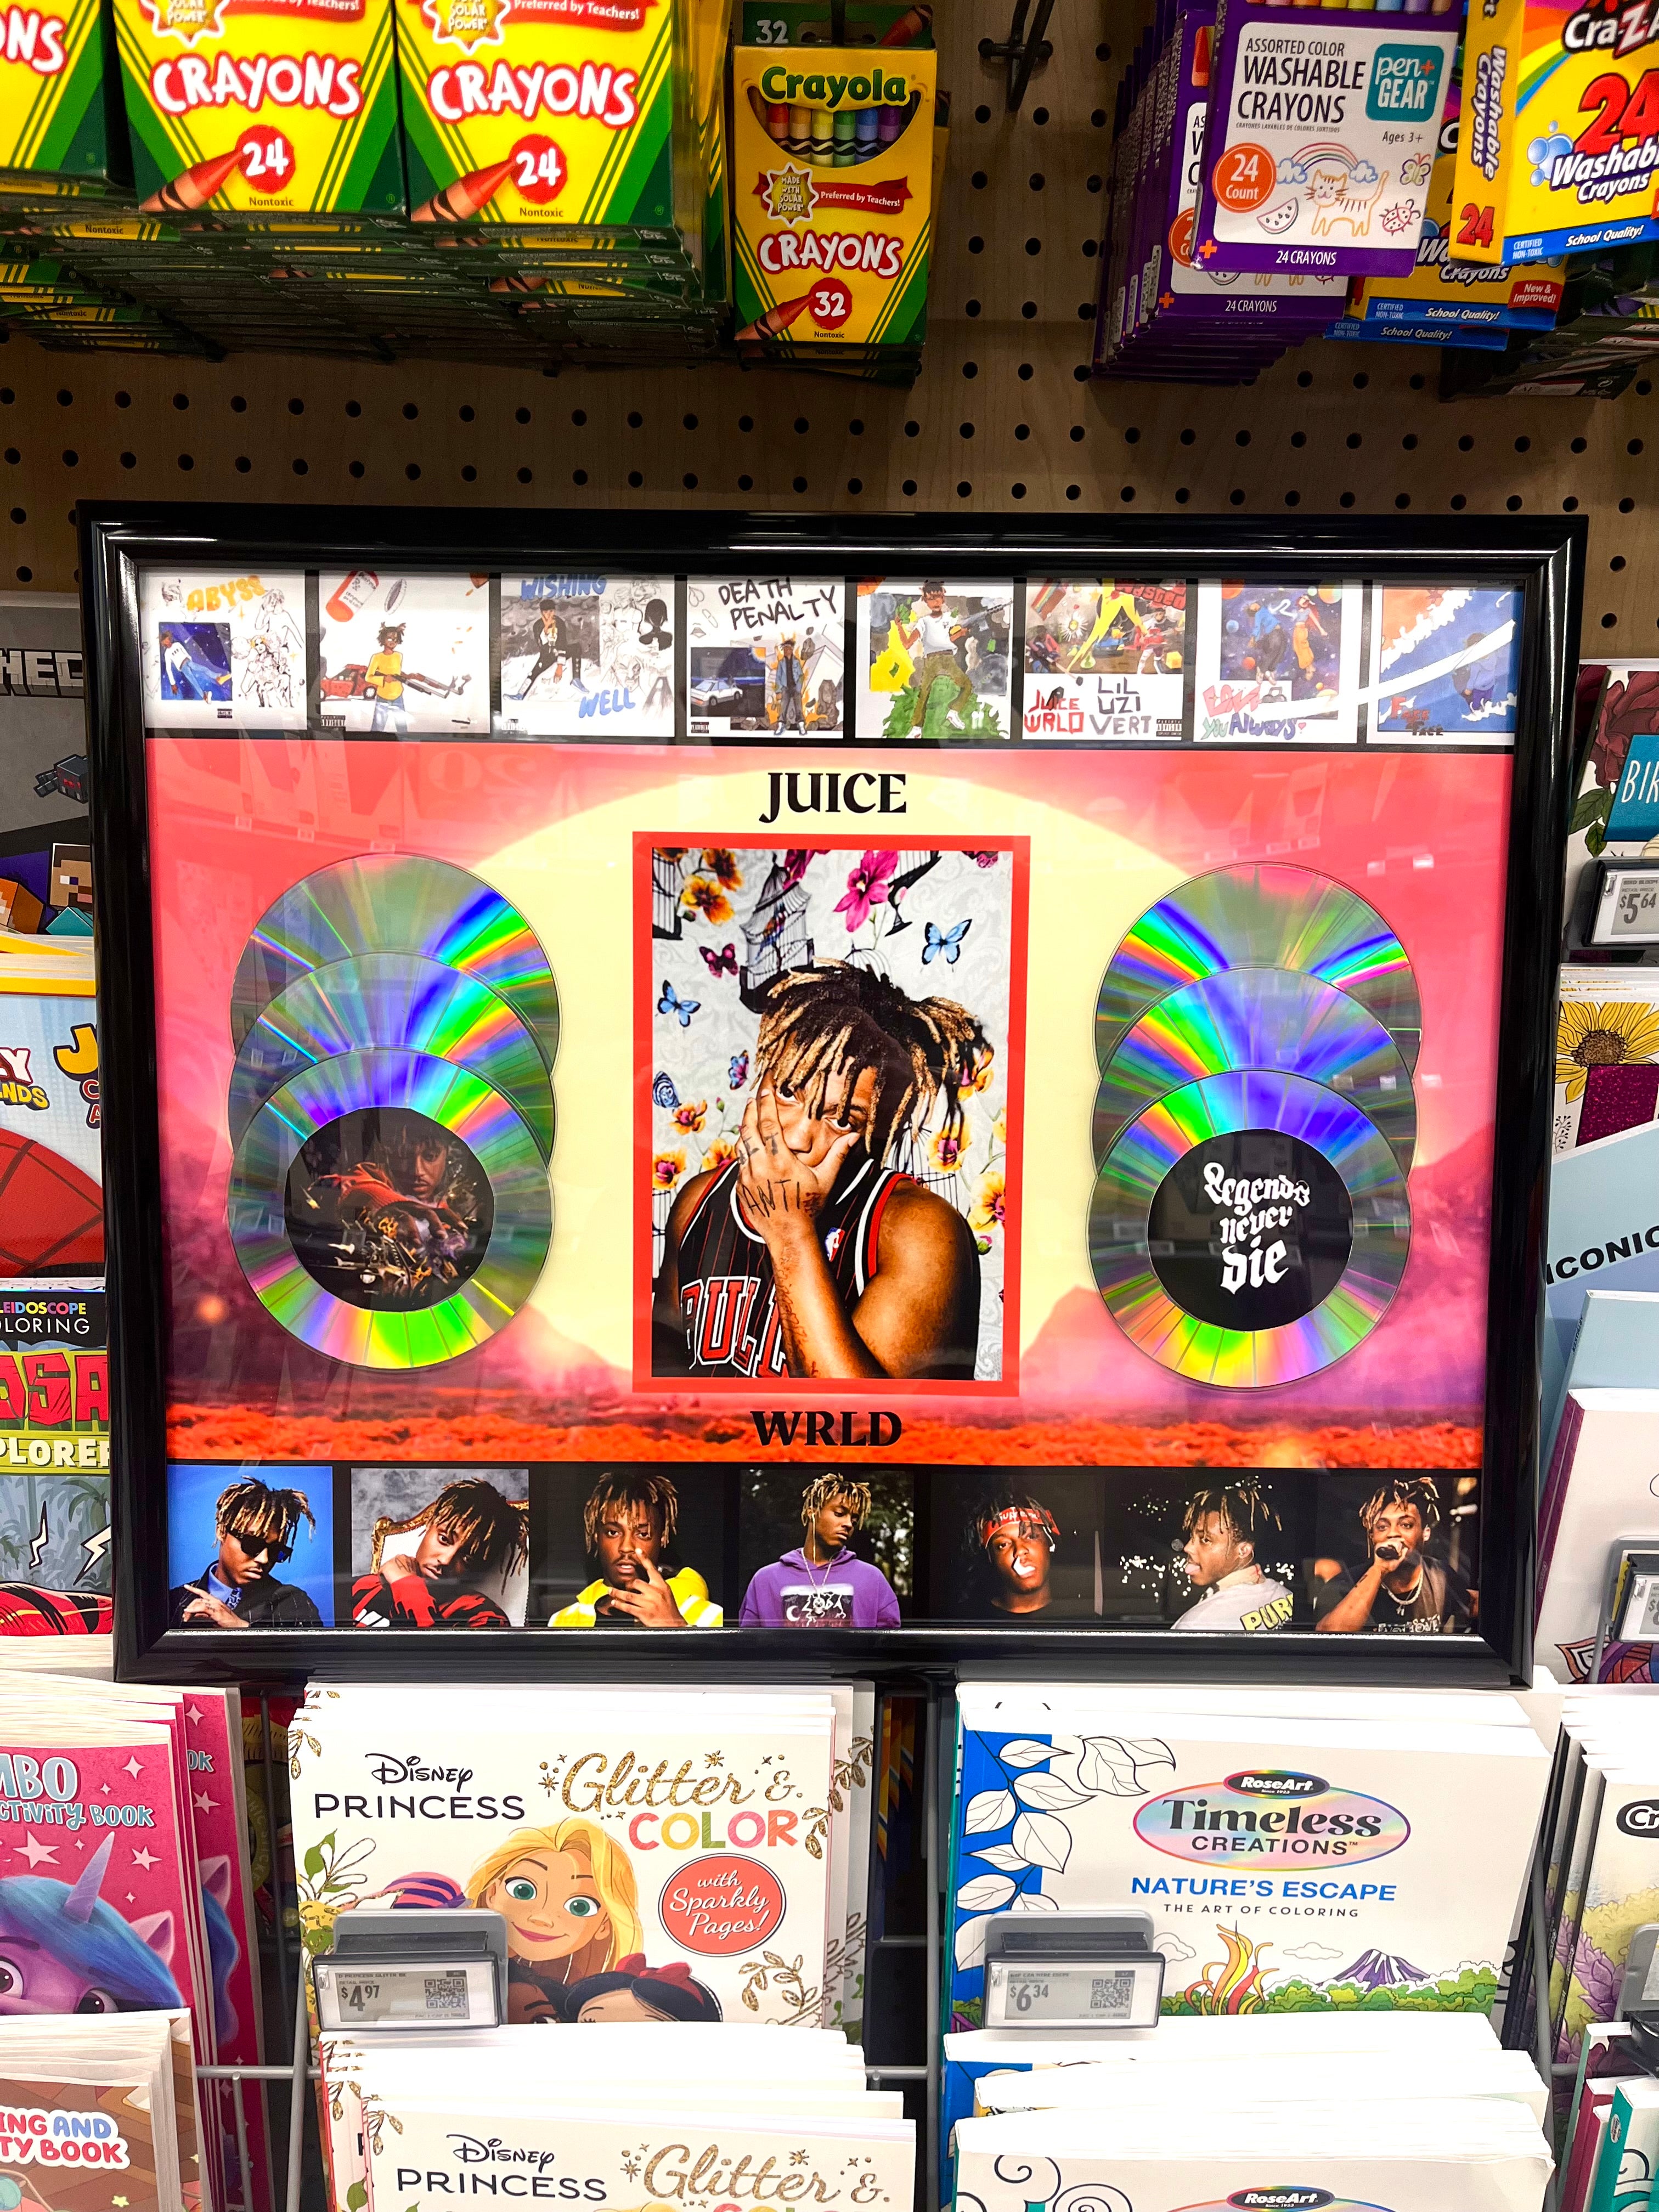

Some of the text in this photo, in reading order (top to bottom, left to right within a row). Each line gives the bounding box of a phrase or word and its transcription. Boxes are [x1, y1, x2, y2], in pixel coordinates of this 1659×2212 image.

[452, 5, 486, 16] SOLAR
[570, 4, 583, 14] by
[588, 4, 640, 20] Teachers!
[755, 20, 788, 44] 32
[1246, 38, 1345, 57] ASSORTED COLOR
[1244, 55, 1366, 89] WASHABLE
[154, 55, 360, 115] CRAYONS
[431, 63, 635, 125] CRAYONS
[762, 67, 906, 106] Crayola
[1378, 79, 1427, 110] GEAR
[1238, 91, 1346, 123] CRAYONS
[1474, 55, 1491, 165] Crayons
[1485, 47, 1506, 179] Washable
[1578, 70, 1659, 151] 24
[1382, 131, 1424, 144] Ages 3+
[242, 139, 289, 178] 24
[516, 149, 561, 186] 24
[1231, 153, 1259, 182] 24
[782, 176, 800, 184] MADE
[1579, 172, 1649, 204] Crayons
[249, 196, 294, 207] Nontoxic
[780, 194, 802, 203] SOLAR
[821, 191, 855, 200] Preferred
[867, 195, 900, 207] Teachers!
[1225, 185, 1259, 201] Count
[520, 207, 563, 217] Nontoxic
[85, 224, 123, 234] Nontoxic
[1460, 204, 1494, 247] 24
[1566, 225, 1644, 247] School Quality!
[760, 233, 901, 275] CRAYONS
[1513, 247, 1544, 259] NON-TOXIC
[1514, 238, 1542, 250] CERTIFIED
[1276, 251, 1338, 267] 24 CRAYONS
[1441, 265, 1509, 284] Crayons
[1513, 293, 1556, 304] Improved!
[1524, 284, 1551, 294] New &
[814, 292, 845, 317] 32
[1225, 300, 1277, 313] 24 CRAYONS
[1375, 311, 1403, 319] NON-TOXIC
[1377, 303, 1403, 311] CERTIFIED
[1426, 308, 1500, 321] School Quality!
[1381, 327, 1452, 340] School Quality!
[187, 574, 266, 612] ABYSS
[521, 574, 607, 601] WISHING
[718, 577, 792, 605] DEATH
[730, 585, 837, 630] PENALTY
[1098, 675, 1139, 695] LIL
[579, 688, 636, 718] WELL
[1024, 696, 1141, 735] WRLD UZI
[1090, 715, 1152, 736] VERT
[759, 772, 906, 823] JUICE
[1220, 1206, 1293, 1244] never
[0, 1318, 90, 1334] LORING
[751, 1410, 902, 1447] WRLD
[365, 1753, 473, 1792] Disney
[561, 1751, 797, 1813] Glitter &
[1241, 1776, 1313, 1791] RoseArt
[91, 1804, 155, 1827] BOOK
[315, 1793, 525, 1820] PRINCESS
[1163, 1799, 1382, 1838] Timeless
[628, 1809, 799, 1850] COLOR
[697, 1870, 742, 1889] with
[1283, 1880, 1397, 1901] ESCAPE
[670, 1886, 769, 1916] Sparkly
[1164, 1903, 1359, 1917] THE ART OF COLORING
[689, 1910, 770, 1940] Pages!
[53, 2115, 111, 2139] AND
[40, 2140, 123, 2164] BOOK
[446, 2134, 555, 2174] Disney
[397, 2168, 607, 2201] PRINCESS
[644, 2144, 884, 2204] Glitter &
[1244, 2193, 1318, 2204] RoseArt
